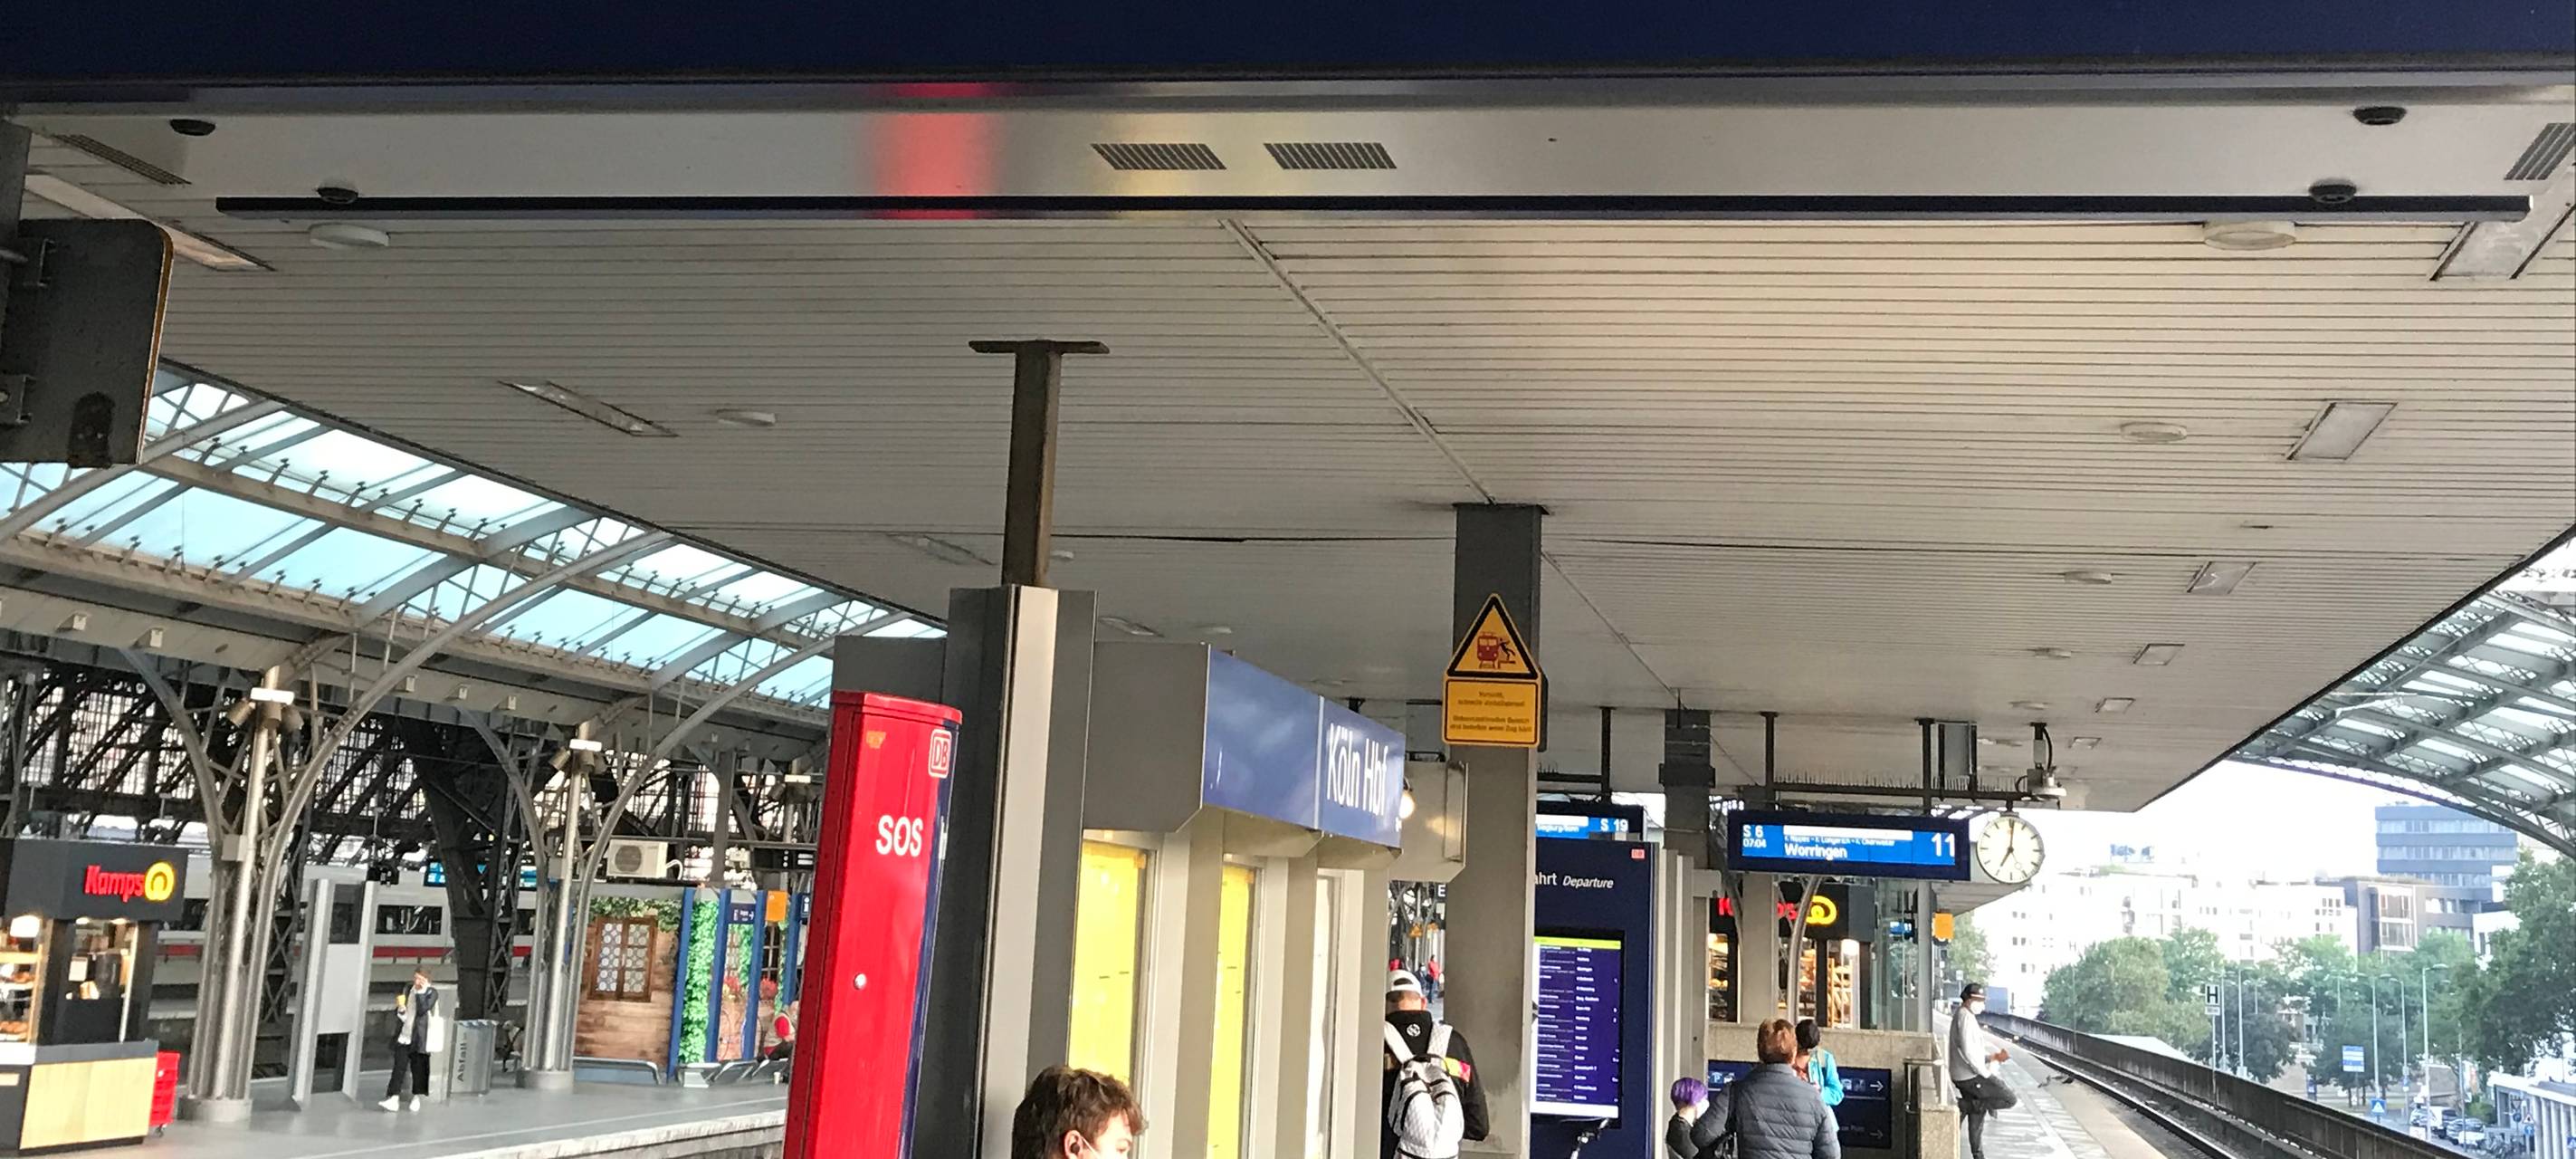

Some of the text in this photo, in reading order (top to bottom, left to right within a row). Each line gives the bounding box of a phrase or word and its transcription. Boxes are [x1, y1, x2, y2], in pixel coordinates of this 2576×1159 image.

[1326, 723, 1389, 817] Köln Hbf
[1600, 818, 1628, 832] S 19
[1742, 824, 1764, 838] S 6
[875, 814, 924, 857] SOS
[1742, 838, 1768, 848] 07:04
[1931, 832, 1955, 857] 11
[1784, 842, 1848, 860] Worringen
[85, 865, 146, 903] Kamps
[1562, 875, 1614, 889] Departure
[2207, 986, 2218, 1004] H
